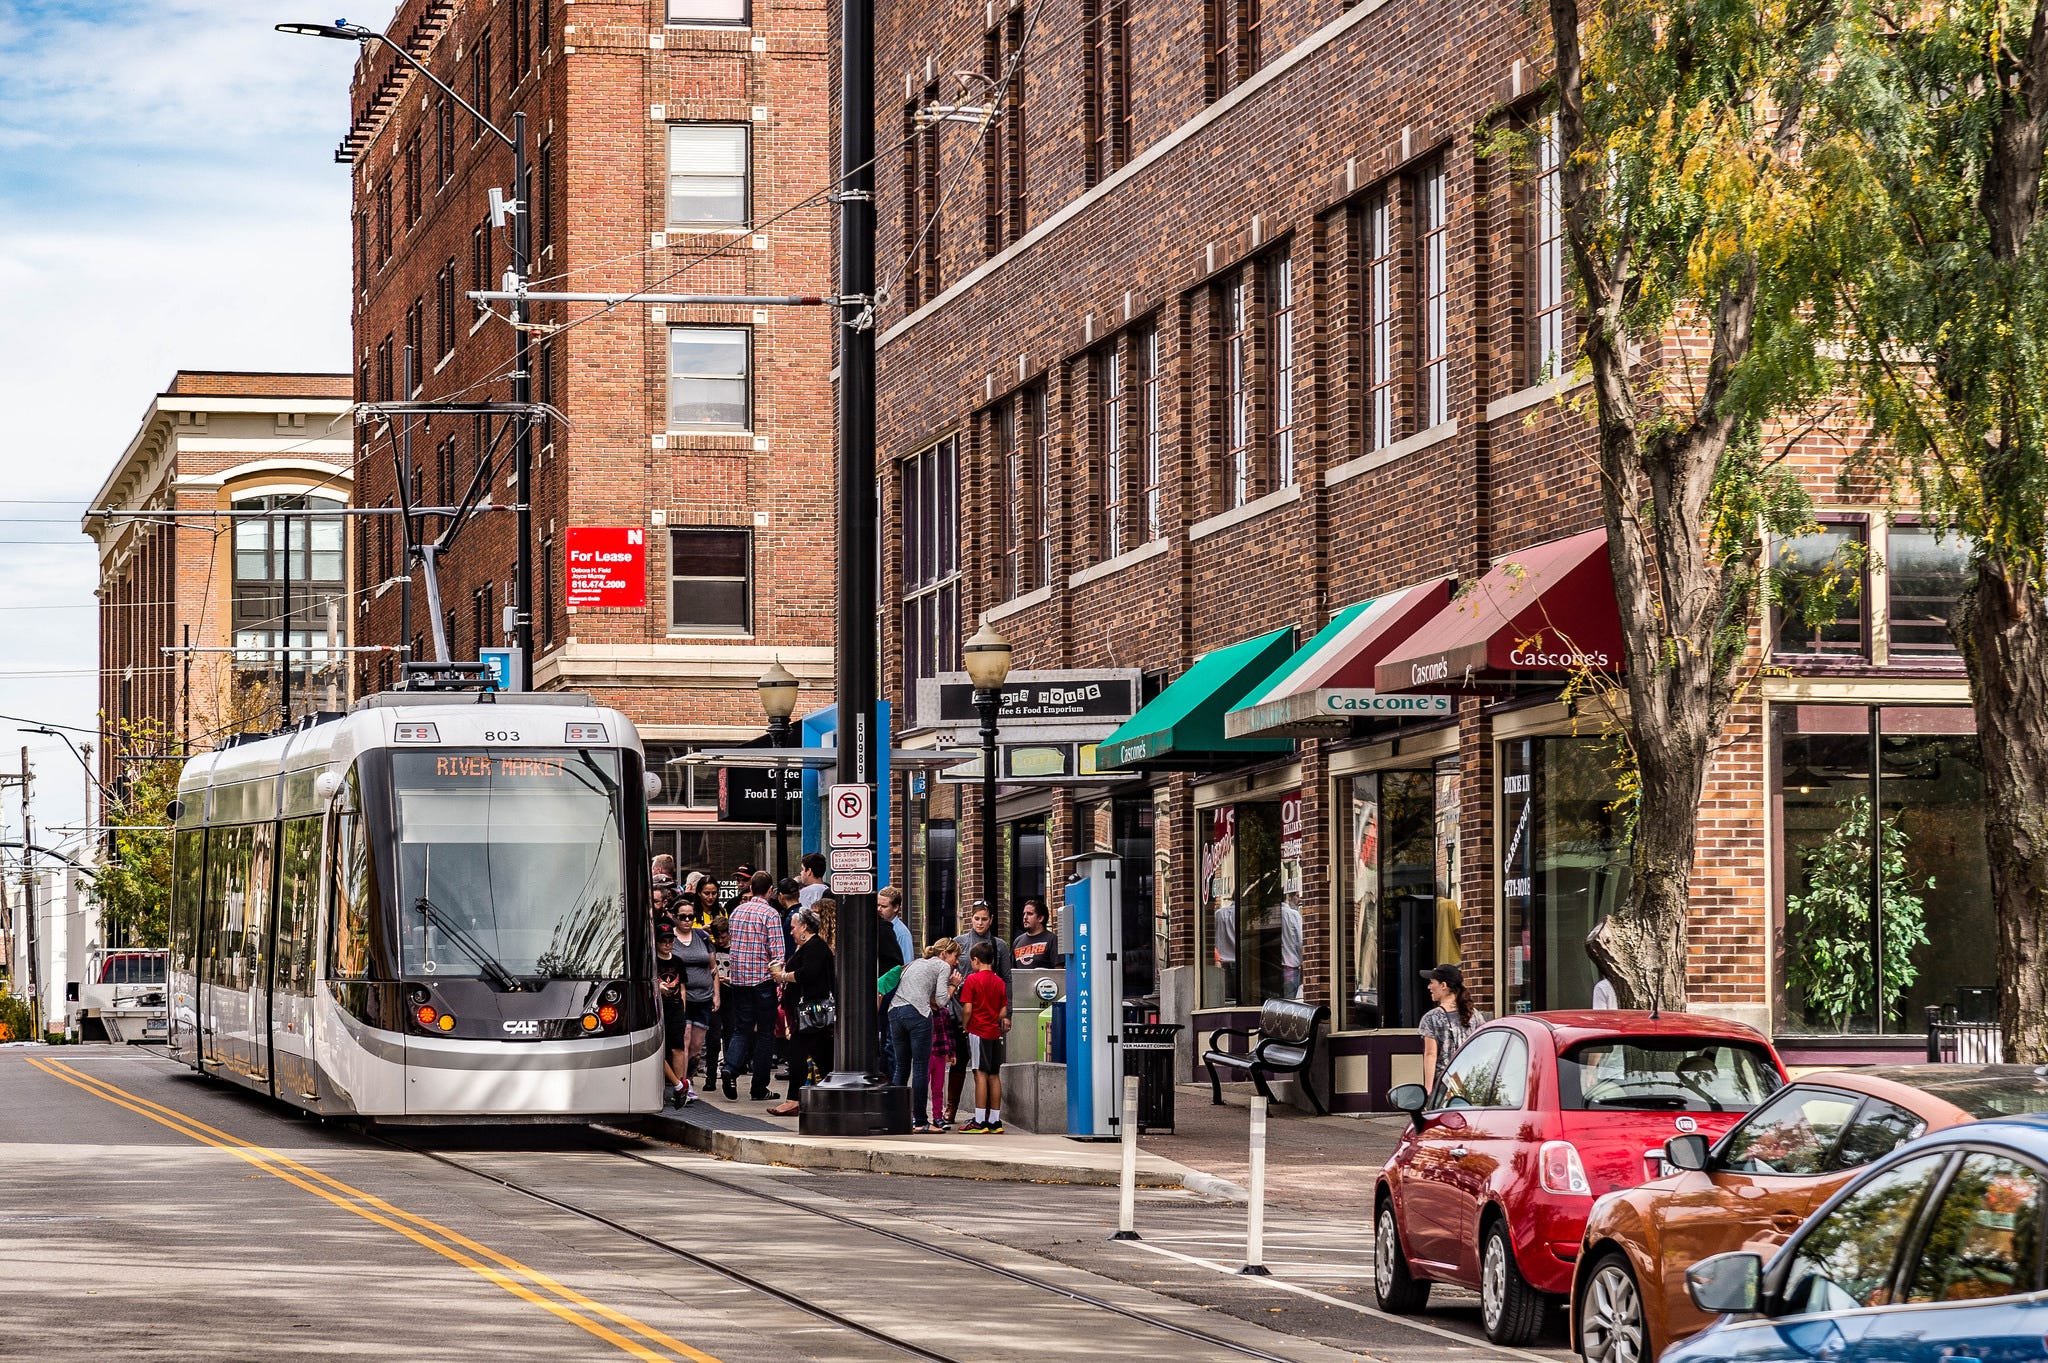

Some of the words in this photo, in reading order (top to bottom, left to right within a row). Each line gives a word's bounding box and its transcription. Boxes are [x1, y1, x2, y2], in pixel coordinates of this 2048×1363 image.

[571, 551, 593, 562] For
[595, 551, 632, 562] Lease
[1509, 649, 1608, 667] Cascone's
[1411, 656, 1448, 685] Cascone's
[1327, 694, 1447, 710] Cascone's
[998, 707, 1014, 715] ffee
[1043, 705, 1084, 714] Emporium
[485, 731, 520, 741] 803
[436, 757, 492, 776] RIVER
[501, 757, 565, 776] MARKET
[744, 788, 768, 799] Food
[1080, 990, 1089, 1042] MARKET
[503, 1020, 538, 1034] CAF
